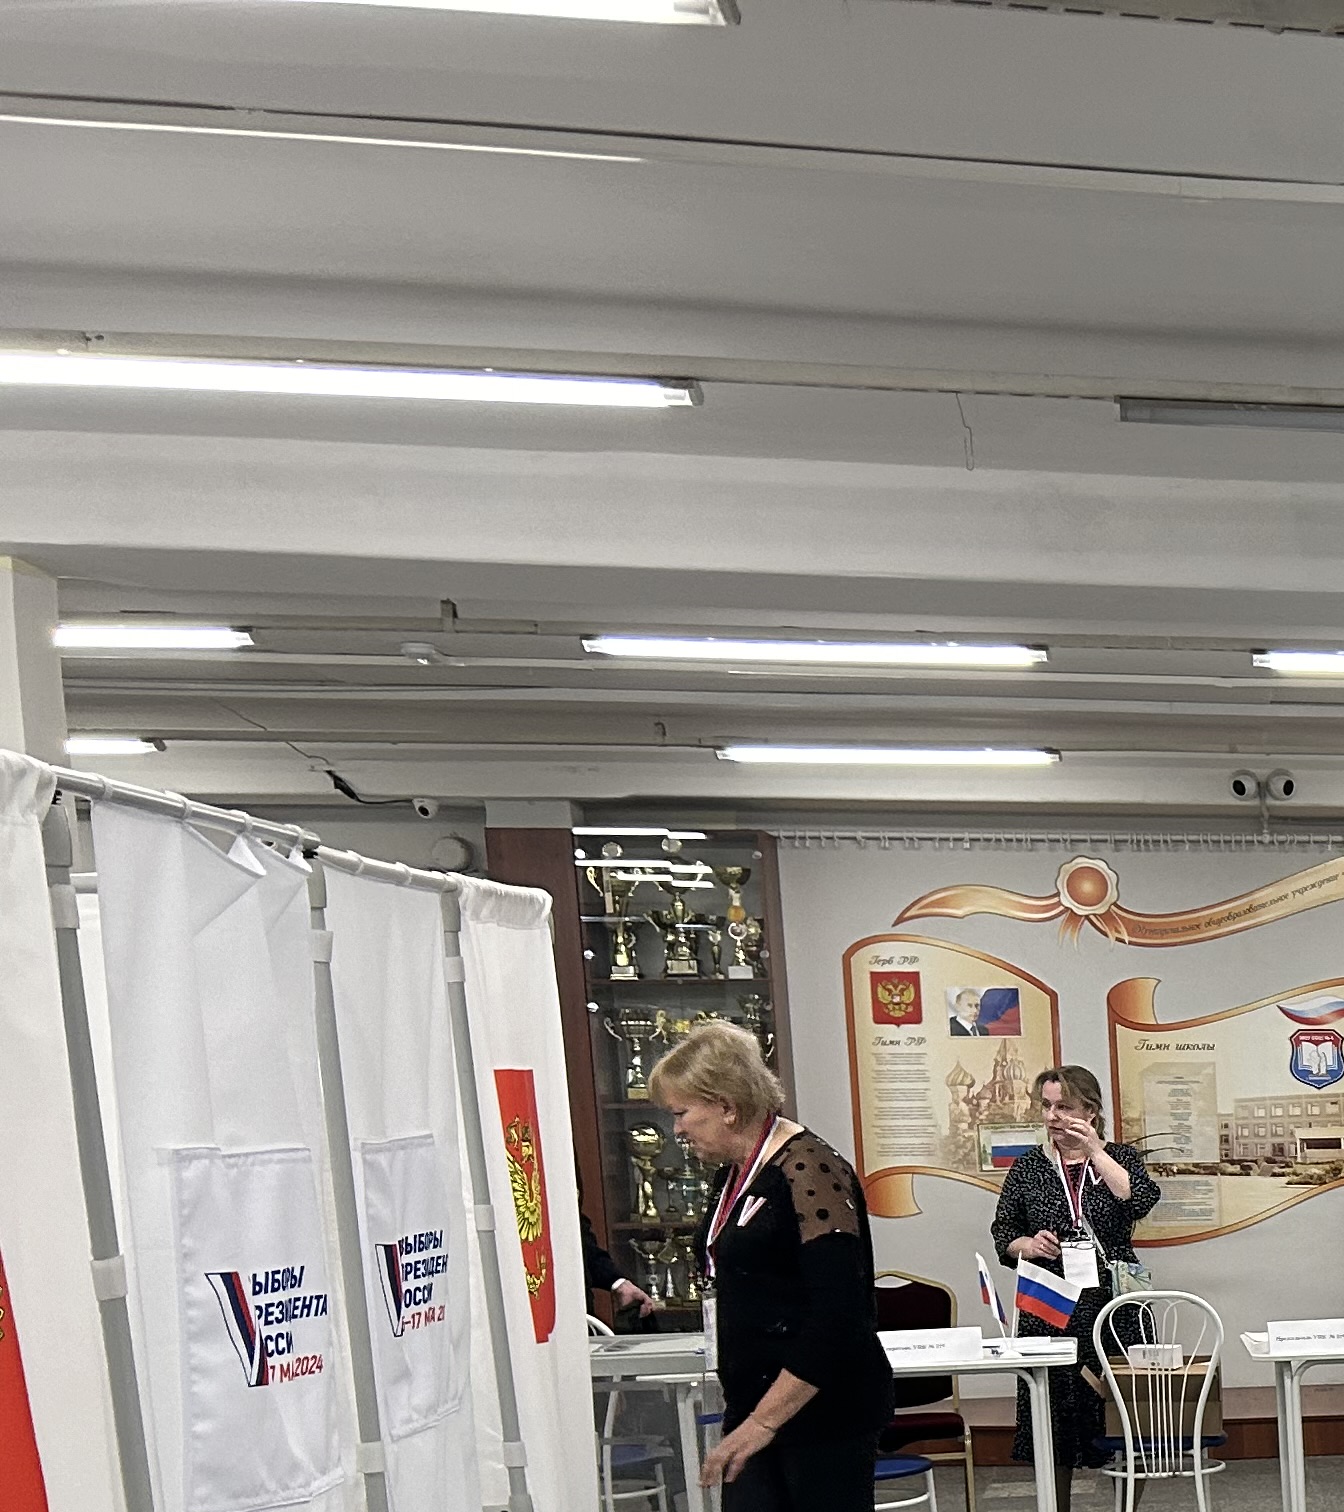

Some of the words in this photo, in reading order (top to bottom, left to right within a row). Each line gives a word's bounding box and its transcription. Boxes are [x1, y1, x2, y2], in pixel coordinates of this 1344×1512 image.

[869, 955, 895, 967] Герб
[872, 1036, 901, 1047] Гимн
[1134, 1039, 1171, 1051] Гимн
[1175, 1042, 1216, 1051] школы
